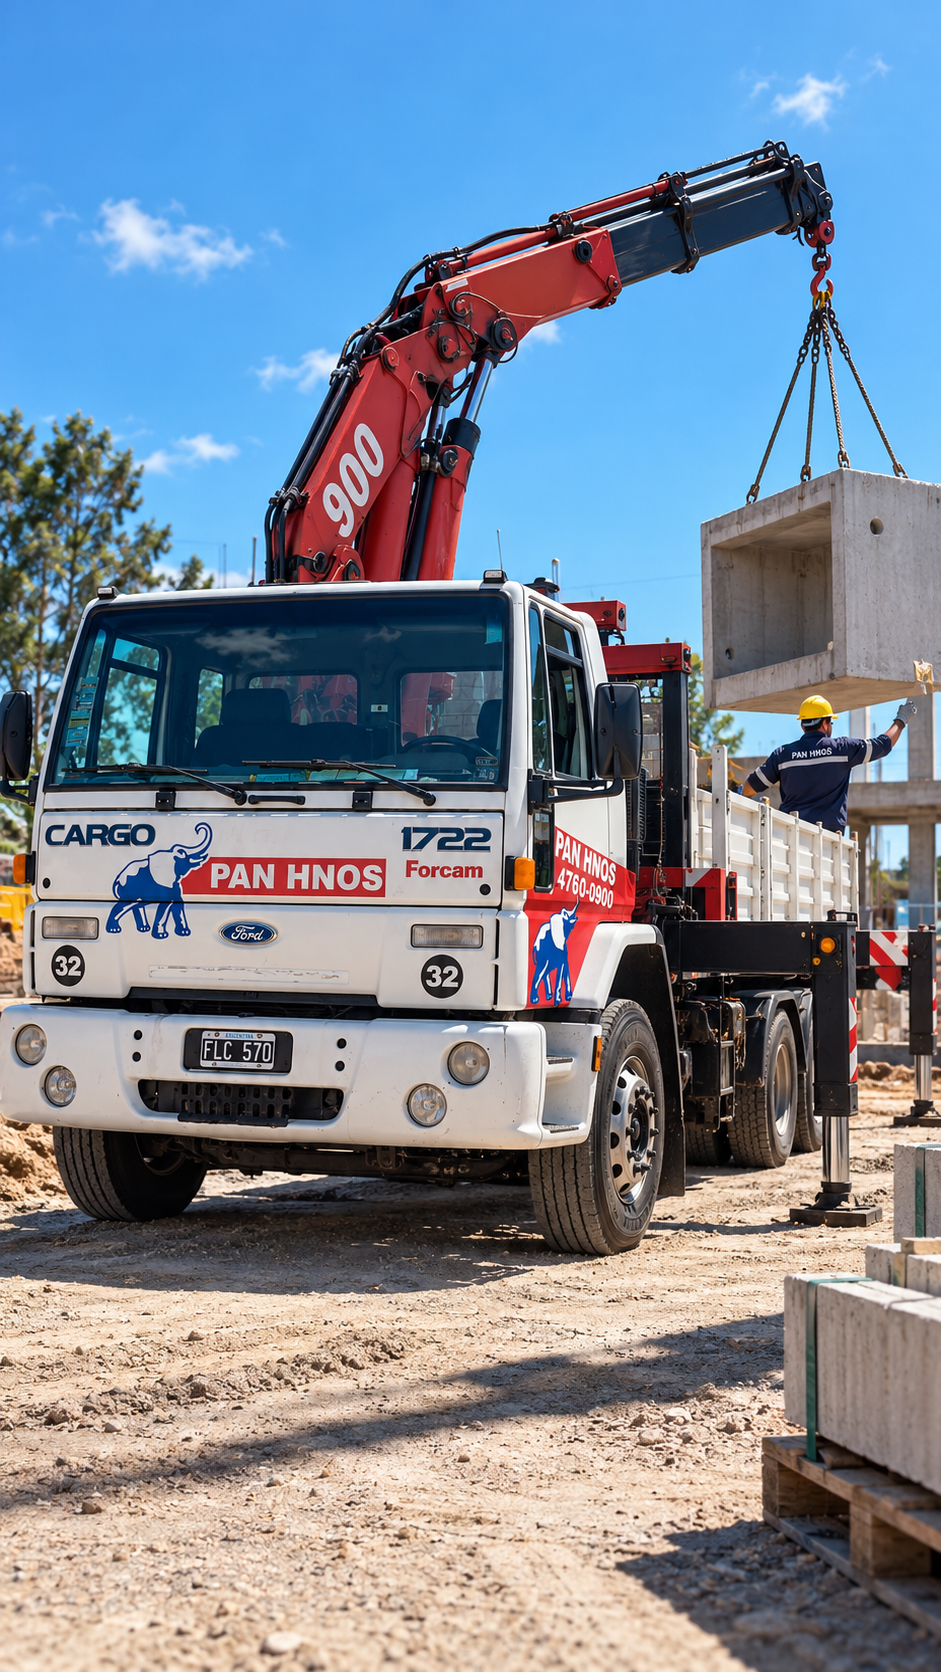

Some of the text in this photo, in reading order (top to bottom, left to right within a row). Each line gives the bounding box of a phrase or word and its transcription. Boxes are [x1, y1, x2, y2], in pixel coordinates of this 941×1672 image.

[323, 423, 384, 538] 900
[791, 751, 808, 759] PAN
[45, 823, 156, 847] CARGO
[401, 826, 493, 851] 1722
[555, 829, 616, 886] PAN HNOS
[210, 861, 384, 892] PAN HNOS
[405, 860, 483, 879] Forcam
[557, 868, 613, 909] 4760-0900
[230, 924, 264, 941] Ford
[55, 956, 82, 977] 32
[425, 965, 459, 988] 32
[203, 1040, 272, 1062] FLC 570
